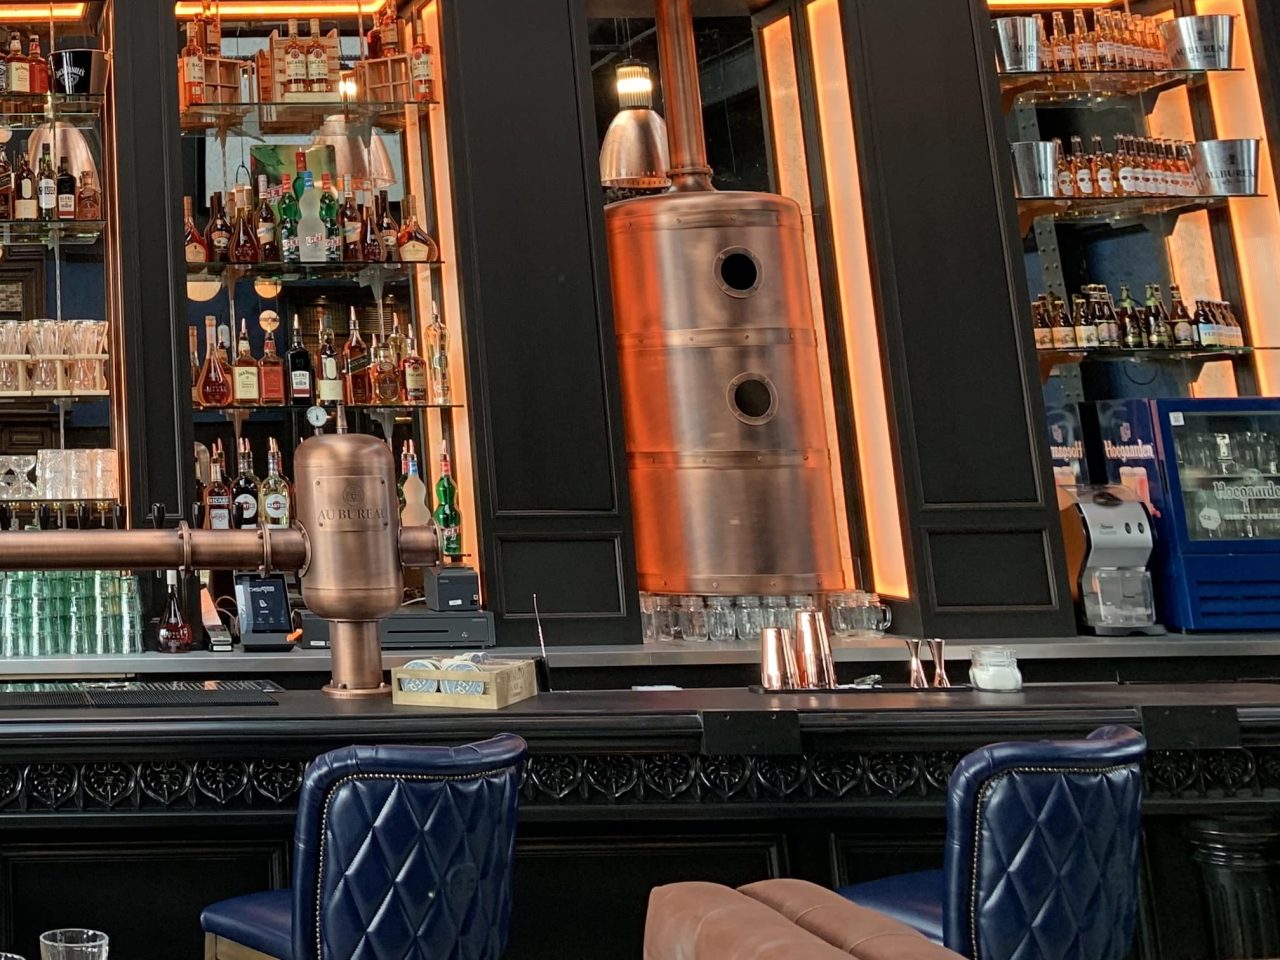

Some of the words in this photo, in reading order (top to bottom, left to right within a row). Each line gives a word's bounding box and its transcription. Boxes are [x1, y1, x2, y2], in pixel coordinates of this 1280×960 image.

[1104, 439, 1156, 463] Hoegaarden
[1213, 481, 1280, 503] Hoegaarde
[319, 509, 335, 520] AU
